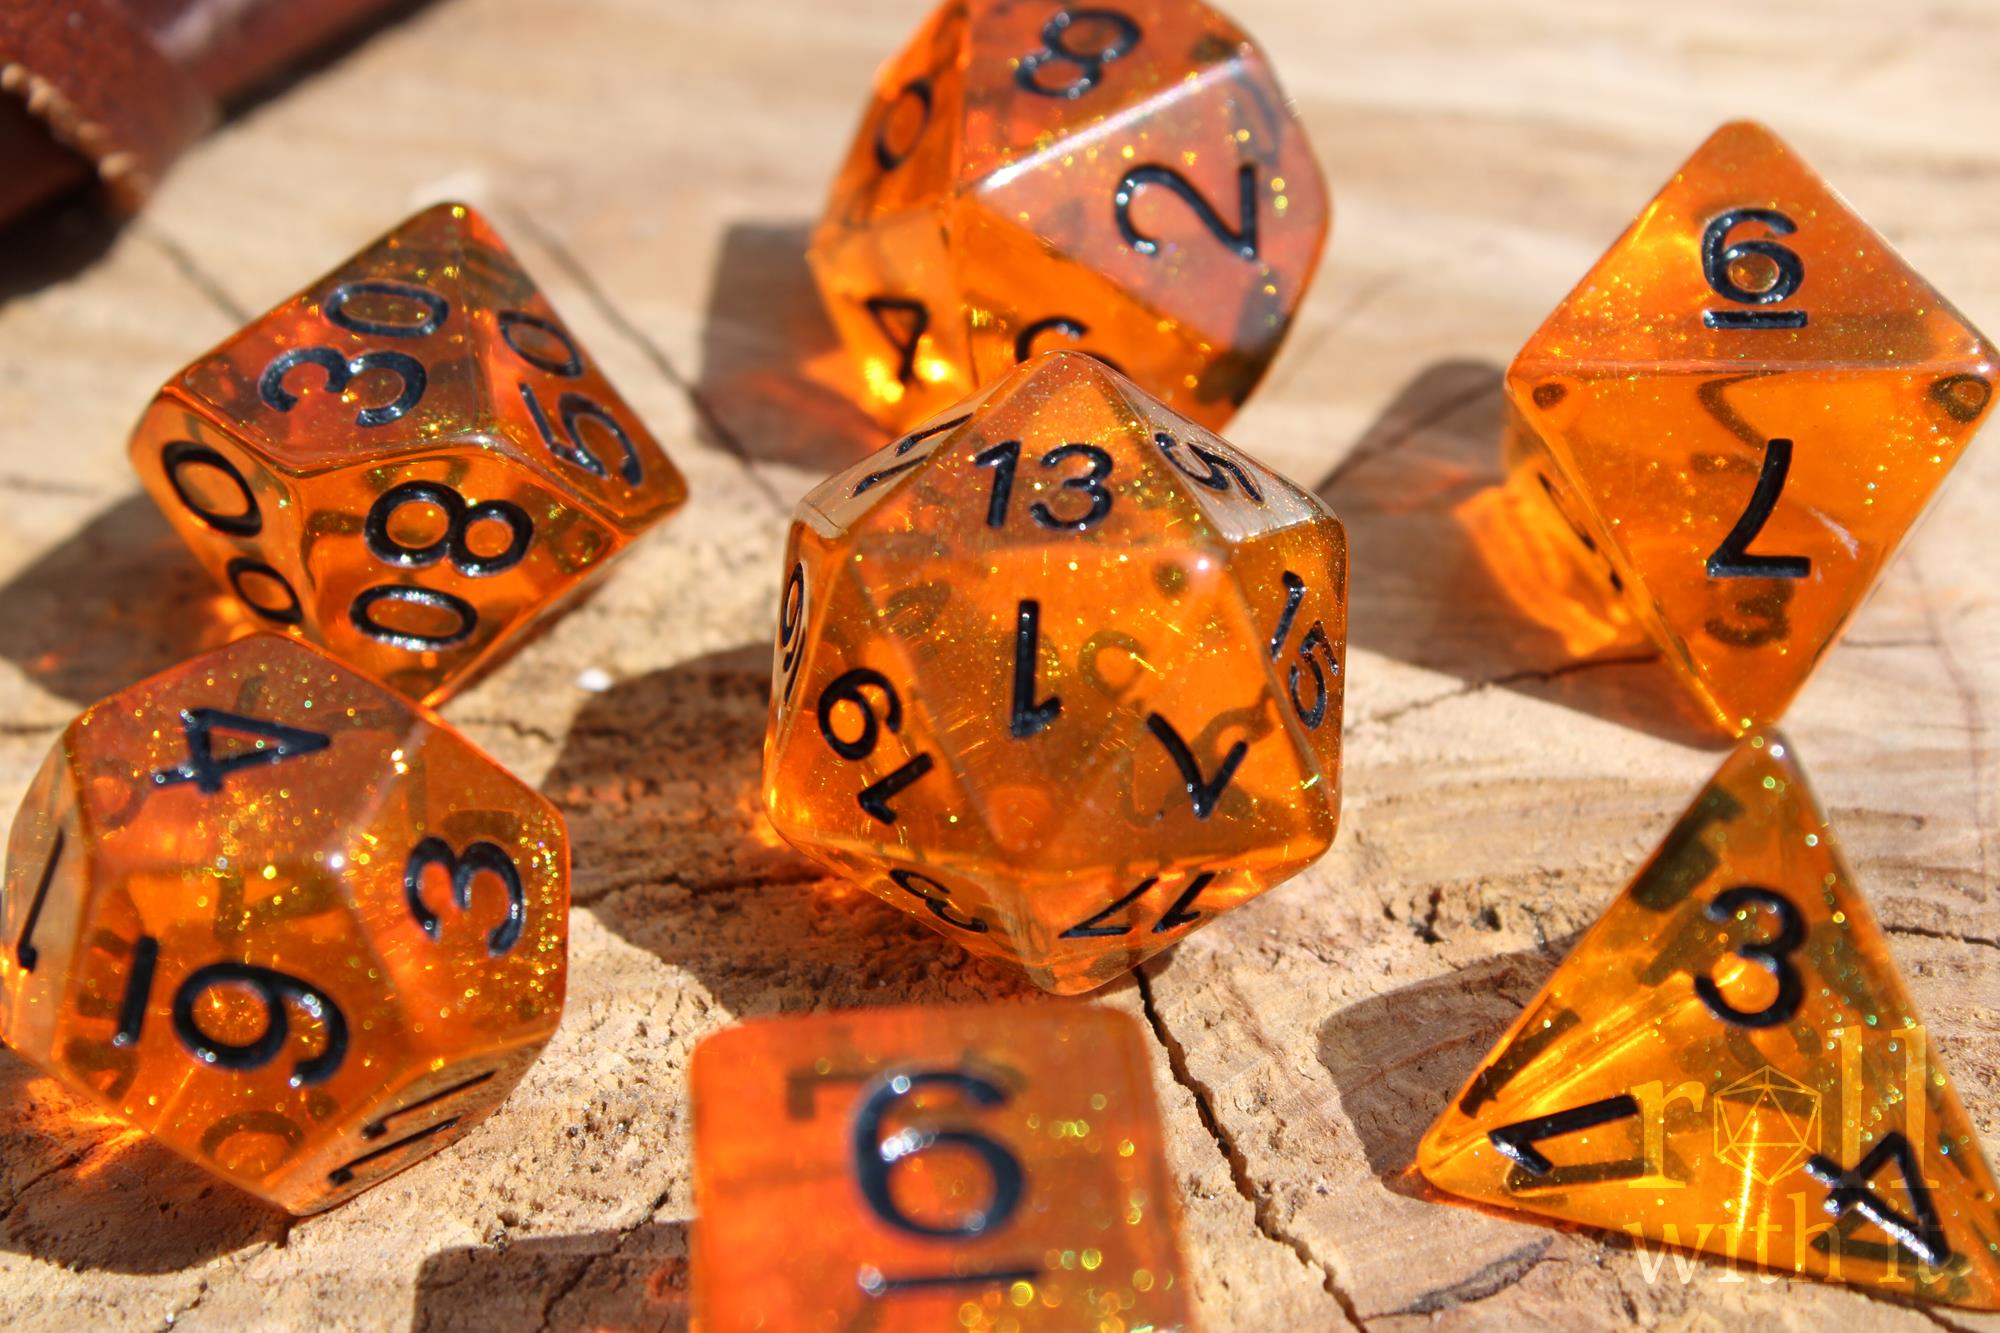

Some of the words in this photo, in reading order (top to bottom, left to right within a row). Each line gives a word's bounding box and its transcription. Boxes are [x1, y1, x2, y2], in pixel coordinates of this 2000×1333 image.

[1015, 9, 1143, 99] 8
[1115, 162, 1258, 260] 2
[1701, 207, 1809, 330] 6
[259, 280, 450, 428] 30
[500, 310, 643, 488] 50
[975, 440, 1114, 530] 13
[1154, 431, 1264, 503] 5
[1706, 438, 1811, 578] 7
[349, 480, 534, 653] 80
[1008, 600, 1063, 739] 1
[1271, 570, 1340, 730] 15
[152, 708, 330, 794] 4
[1147, 711, 1249, 819] 7
[405, 836, 526, 958] 3
[889, 869, 989, 934] 3
[1694, 886, 1809, 1028] 3
[856, 1068, 1042, 1292] 6
[1489, 1094, 1640, 1176] 1
[1803, 1132, 1951, 1263] 4
